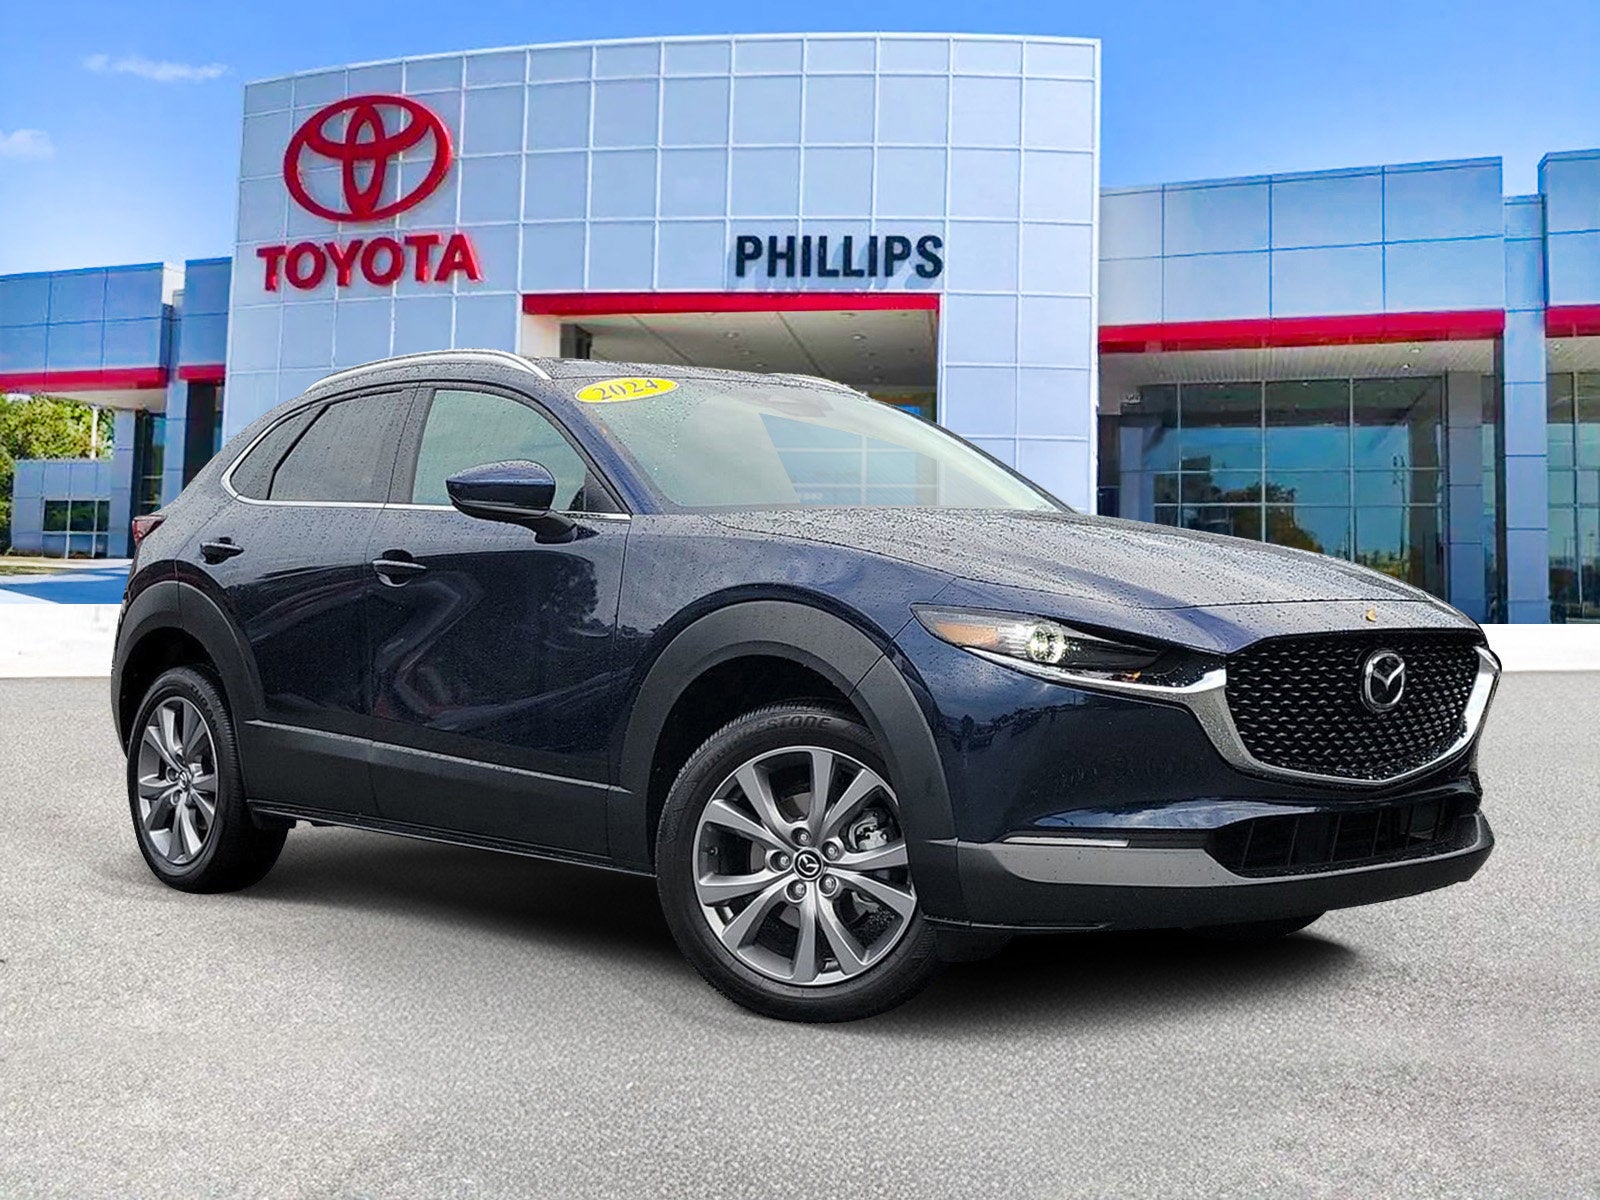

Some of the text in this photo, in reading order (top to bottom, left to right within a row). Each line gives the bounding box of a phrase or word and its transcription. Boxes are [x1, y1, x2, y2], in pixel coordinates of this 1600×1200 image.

[256, 233, 482, 292] TOYOTA
[735, 235, 943, 279] PHILLIPS
[592, 378, 659, 401] 2024
